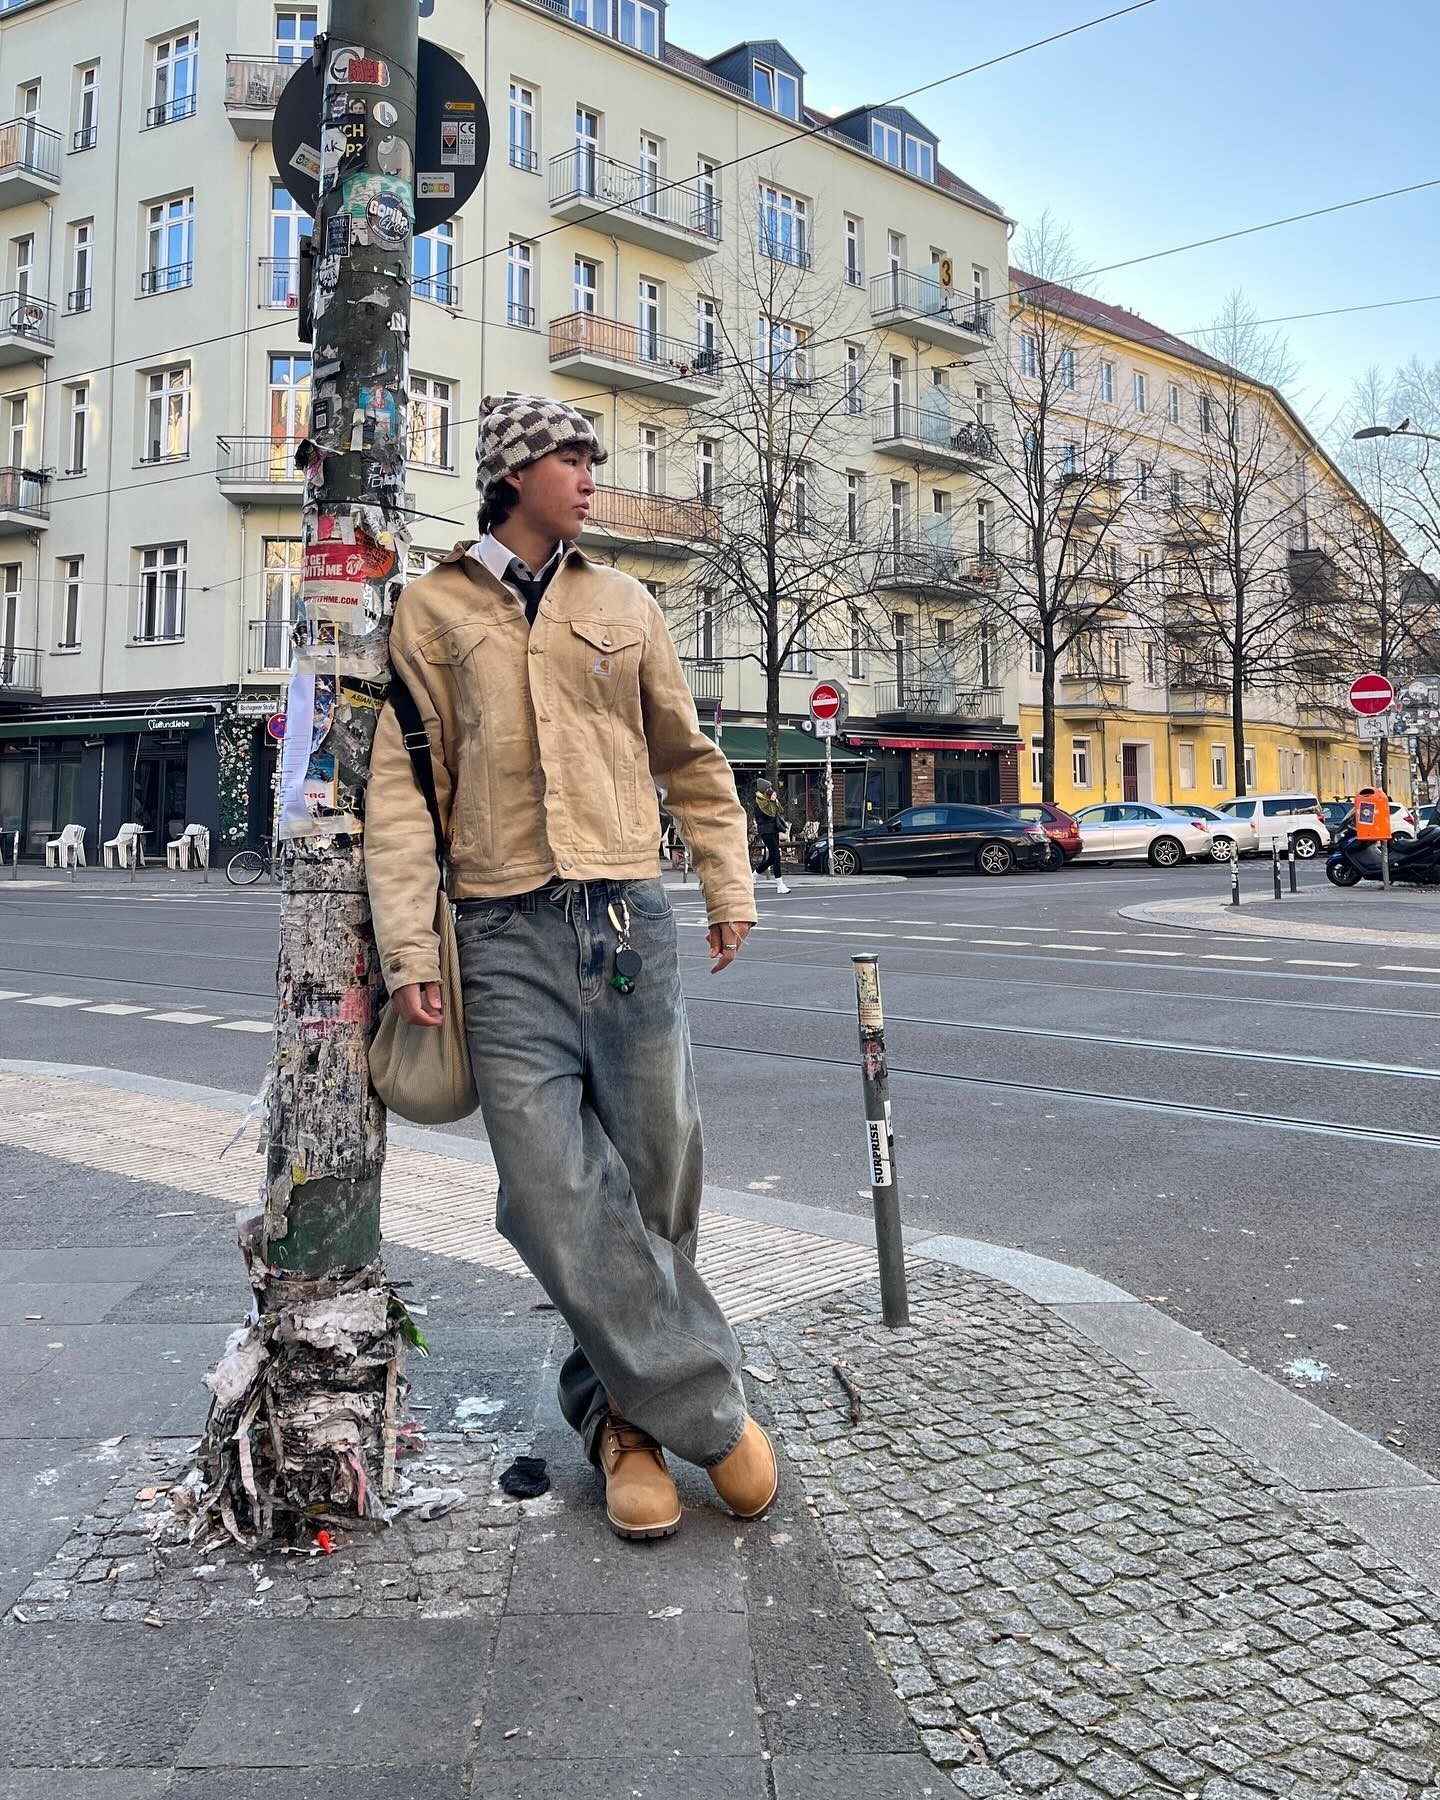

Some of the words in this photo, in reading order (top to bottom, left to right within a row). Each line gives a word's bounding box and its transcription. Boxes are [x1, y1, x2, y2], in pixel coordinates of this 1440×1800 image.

[340, 124, 364, 137] CH
[942, 260, 951, 286] 3
[310, 554, 327, 566] GET
[326, 564, 343, 577] ME
[351, 694, 372, 705] ASIAN
[870, 1123, 884, 1184] SURPRISE
